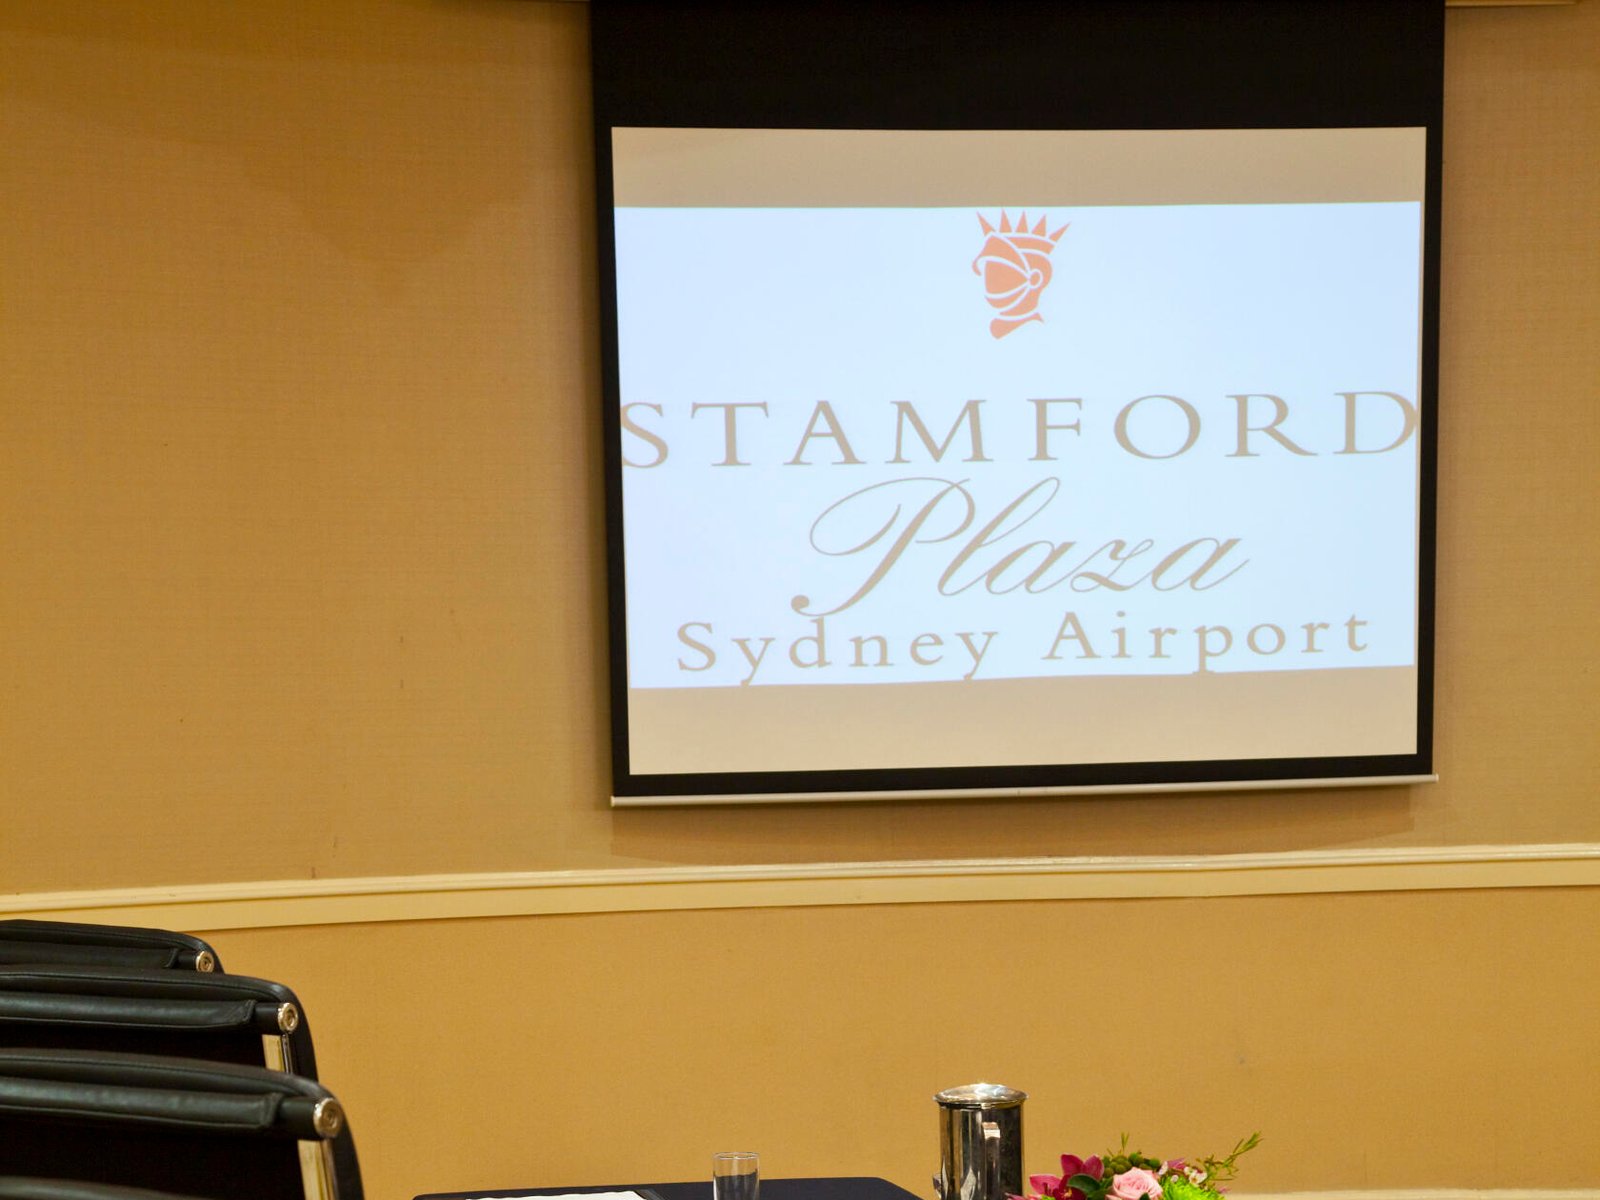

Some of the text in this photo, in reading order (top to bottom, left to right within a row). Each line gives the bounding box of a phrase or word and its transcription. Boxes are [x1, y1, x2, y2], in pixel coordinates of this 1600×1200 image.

[621, 392, 1417, 468] STAMFORD
[792, 477, 1249, 617] Plaza
[678, 612, 1368, 684] Sydney Airport
